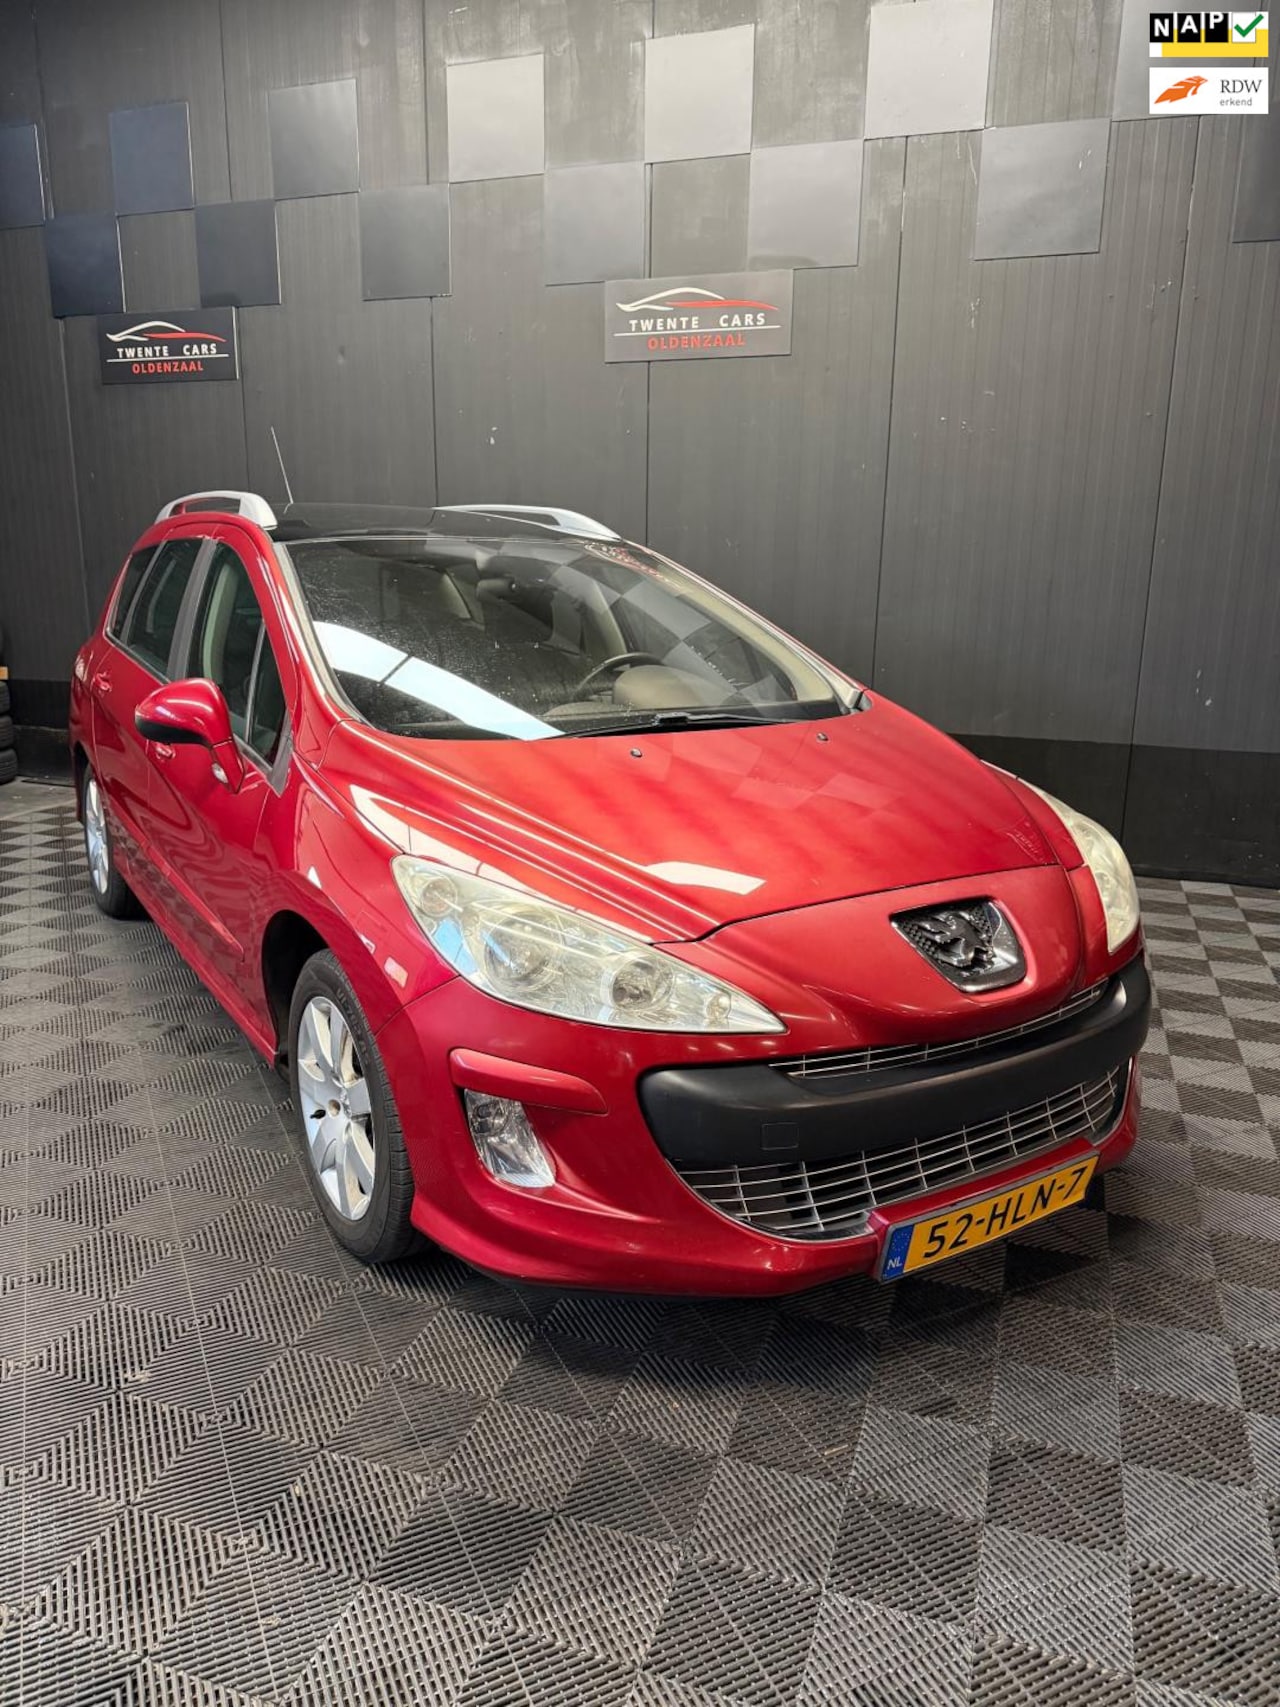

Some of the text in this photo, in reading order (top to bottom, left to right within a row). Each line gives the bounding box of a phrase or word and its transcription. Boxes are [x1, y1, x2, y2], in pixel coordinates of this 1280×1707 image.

[629, 313, 765, 331] TWENTE CARS
[647, 334, 746, 350] OLDENZAAL
[117, 343, 217, 358] TWENTE CARS
[132, 361, 204, 374] OLDENZAAL
[922, 1166, 1088, 1259] 52-HLN-7
[887, 1256, 904, 1271] NL
